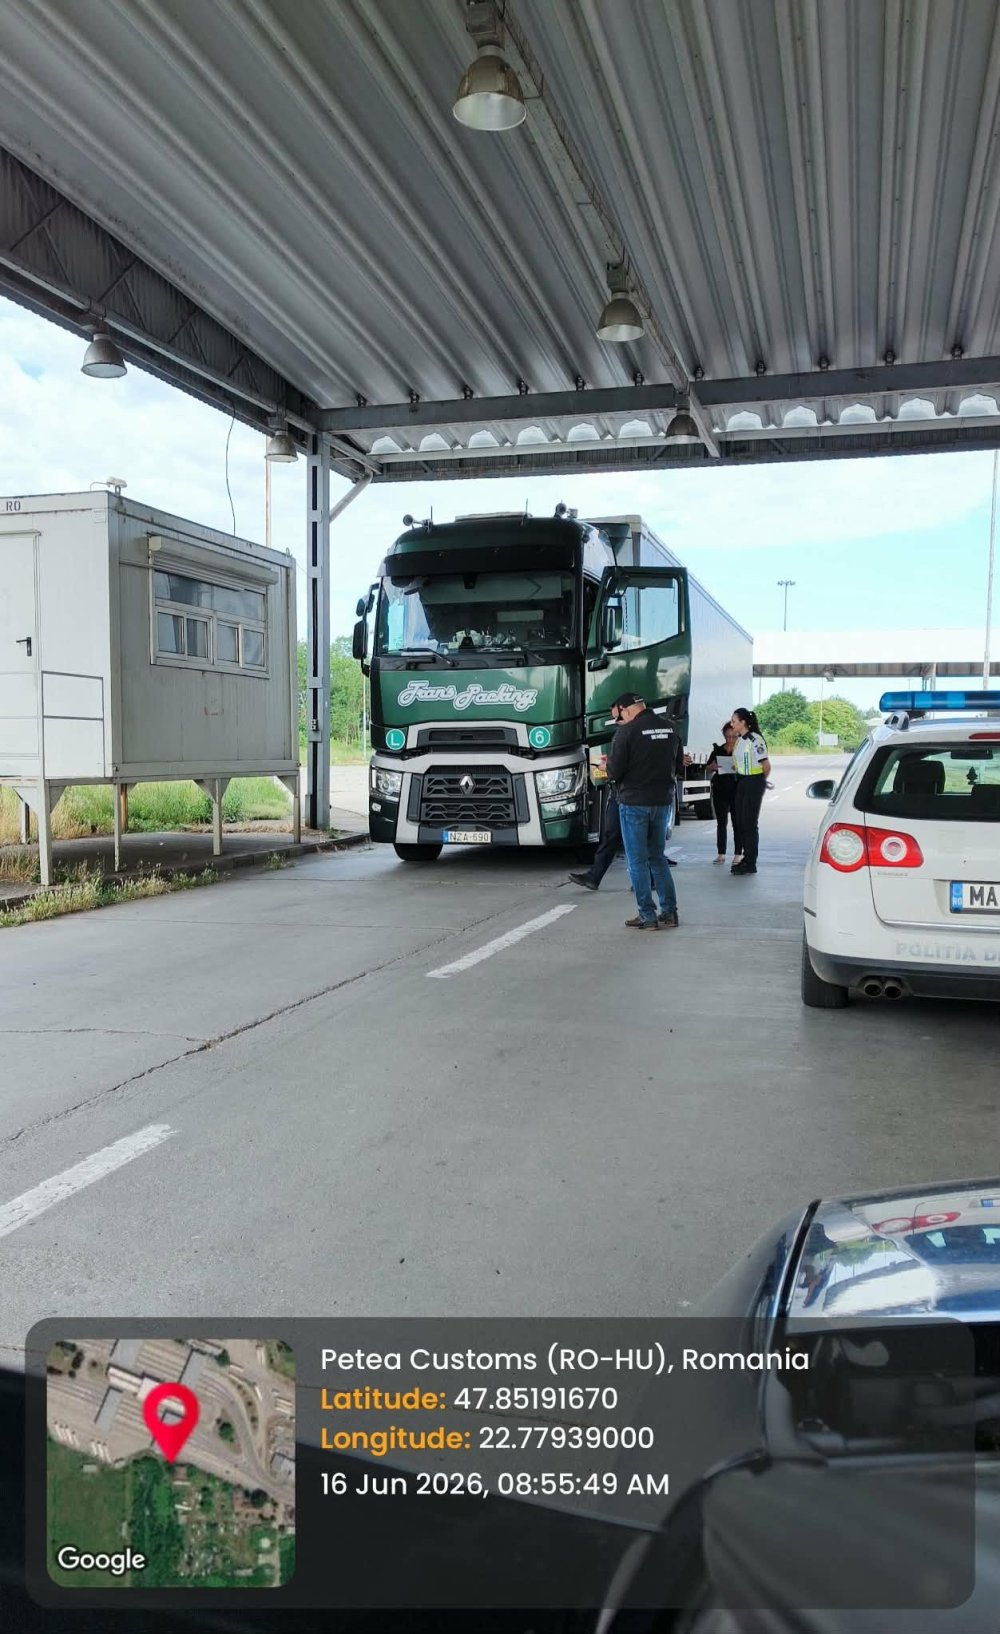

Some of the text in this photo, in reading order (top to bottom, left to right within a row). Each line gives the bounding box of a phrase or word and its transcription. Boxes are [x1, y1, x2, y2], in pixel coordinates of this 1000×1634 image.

[398, 680, 538, 712] Trans Packing
[392, 731, 400, 746] L
[534, 730, 545, 744] 6
[970, 886, 998, 906] MA
